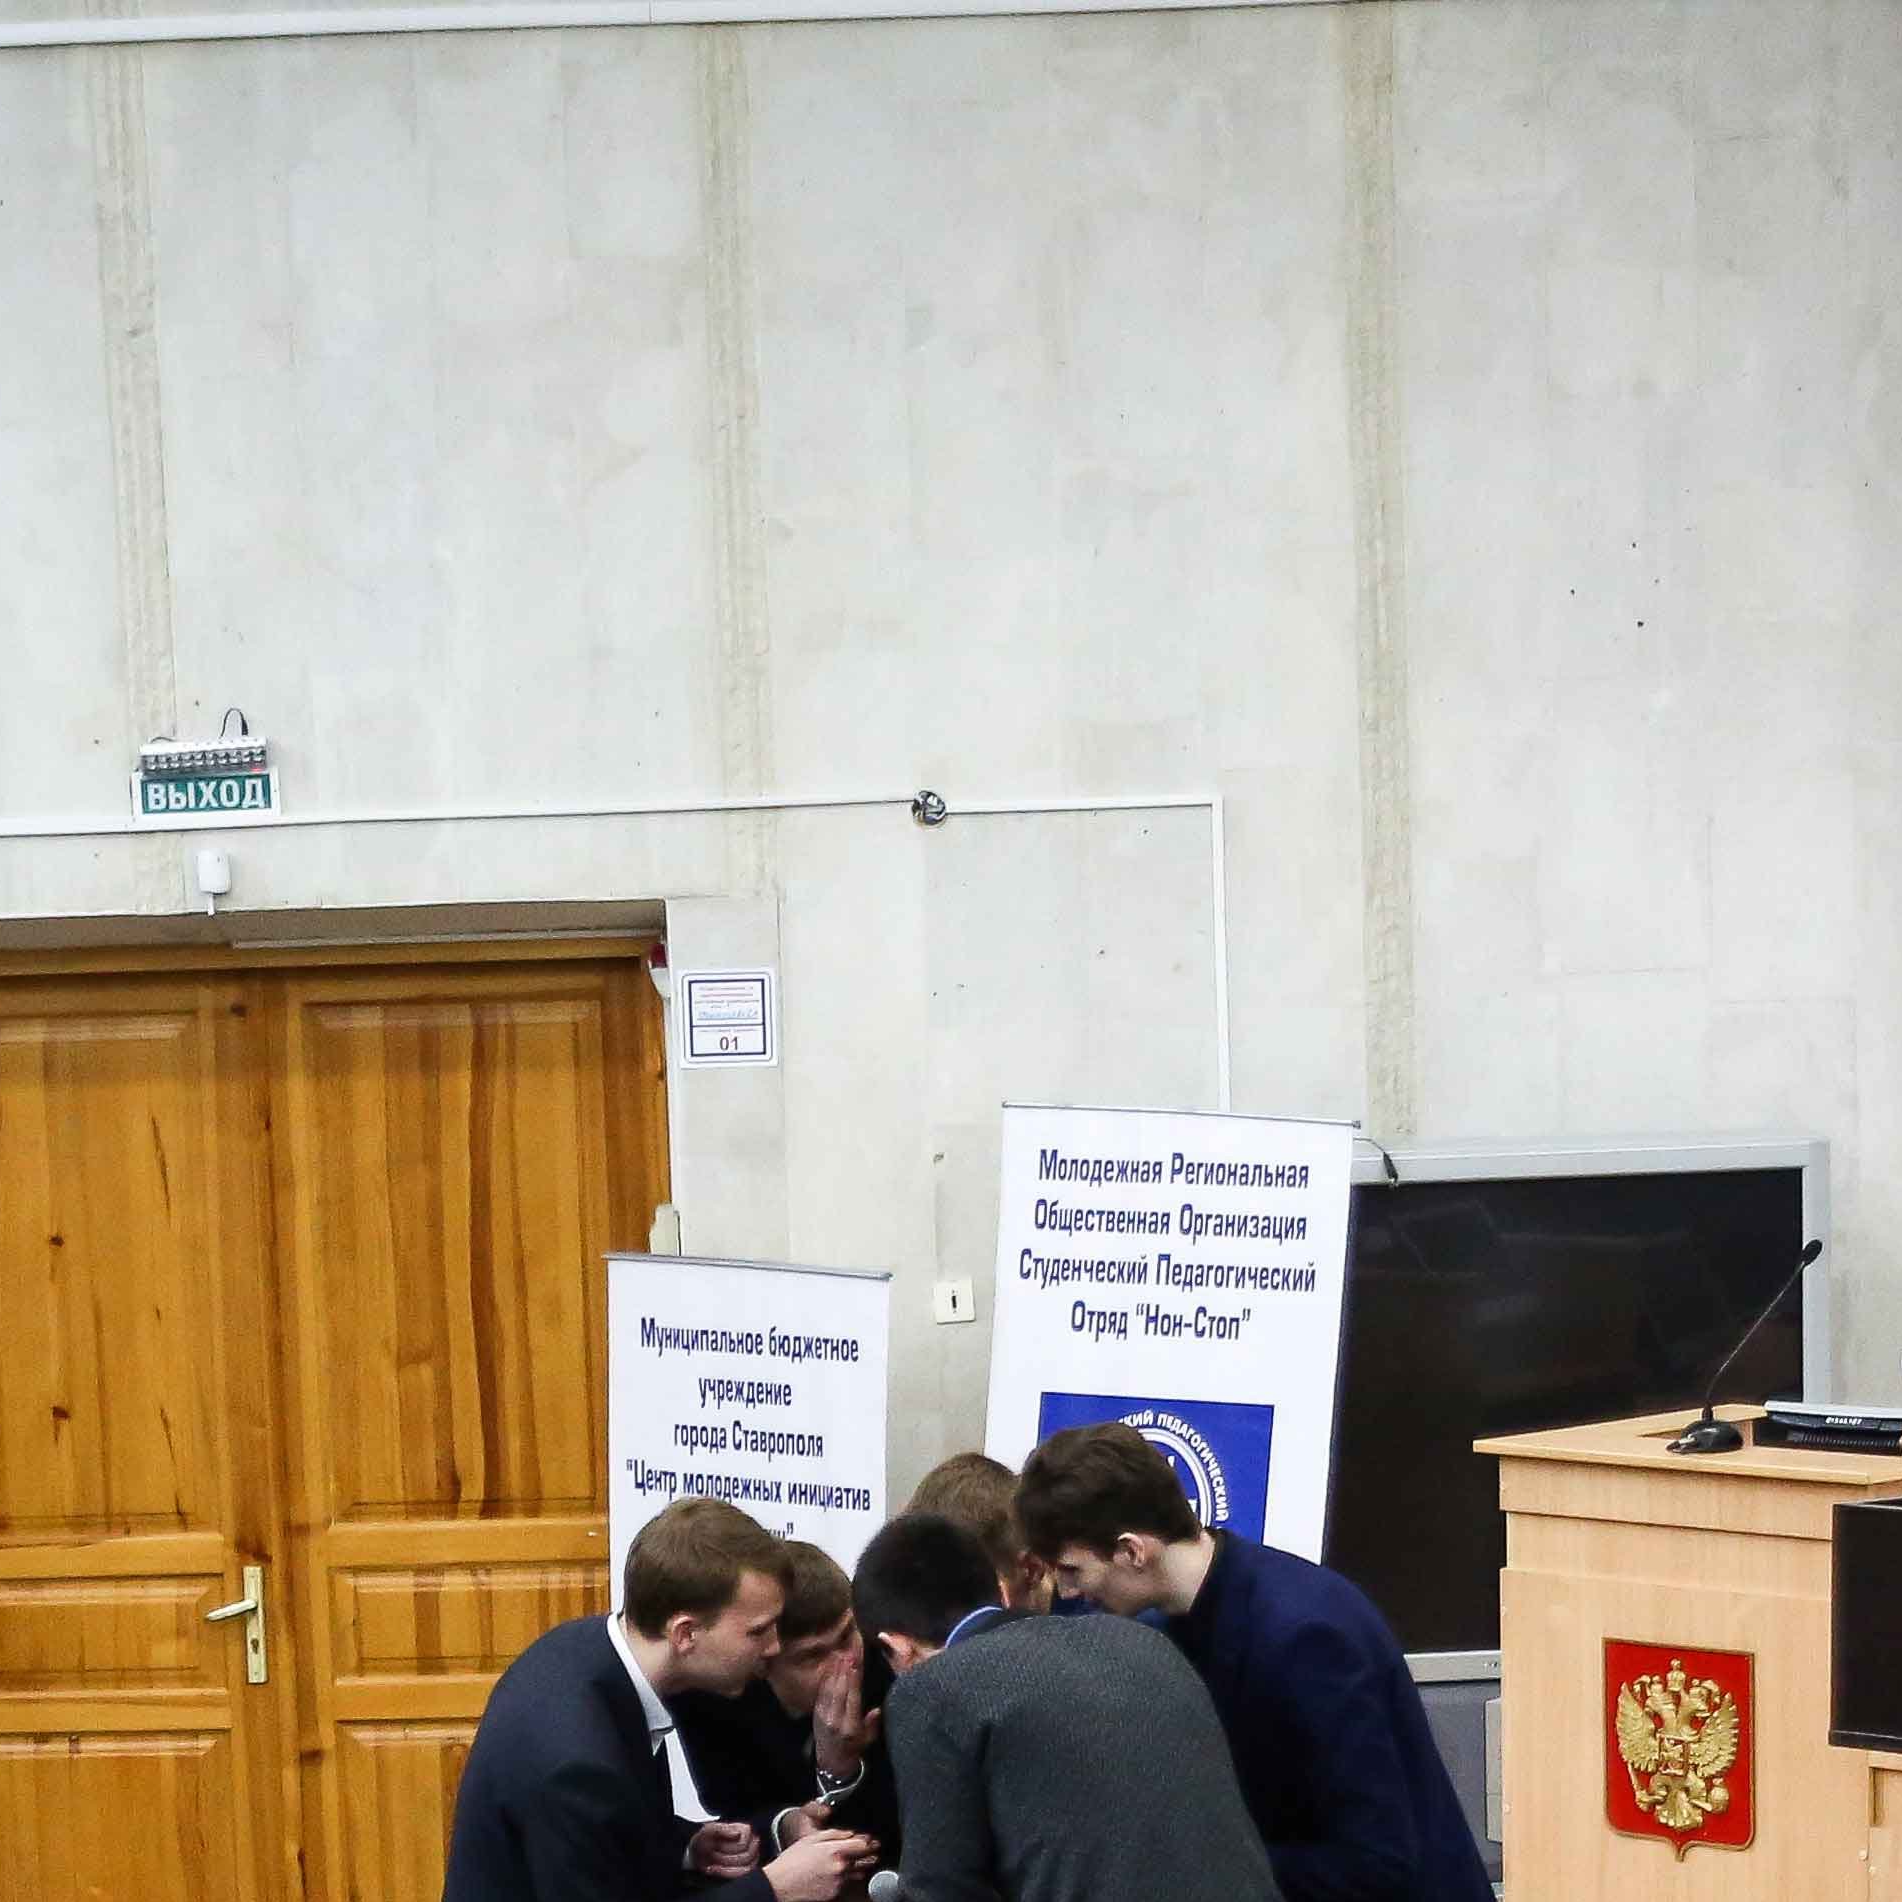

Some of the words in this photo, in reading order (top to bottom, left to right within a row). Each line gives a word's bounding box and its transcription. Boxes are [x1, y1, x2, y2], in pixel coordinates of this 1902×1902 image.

[148, 779, 265, 811] ВЫХОД
[719, 1036, 738, 1051] 01
[1038, 1148, 1163, 1188] Молодежная
[1170, 1152, 1309, 1189] Региональная
[1034, 1198, 1171, 1237] Общественная
[1179, 1203, 1307, 1246] Организация
[1019, 1248, 1148, 1290] Студенческий
[1156, 1253, 1316, 1292] Педагогический
[640, 1317, 763, 1357] Муниципальное
[768, 1326, 859, 1363] бюджетное
[1070, 1300, 1128, 1342] Отряд
[698, 1376, 792, 1409] учреждение
[674, 1423, 727, 1455] города
[732, 1420, 823, 1462] Ставрополя
[683, 1472, 782, 1504] молодежных
[788, 1483, 871, 1512] инициатив
